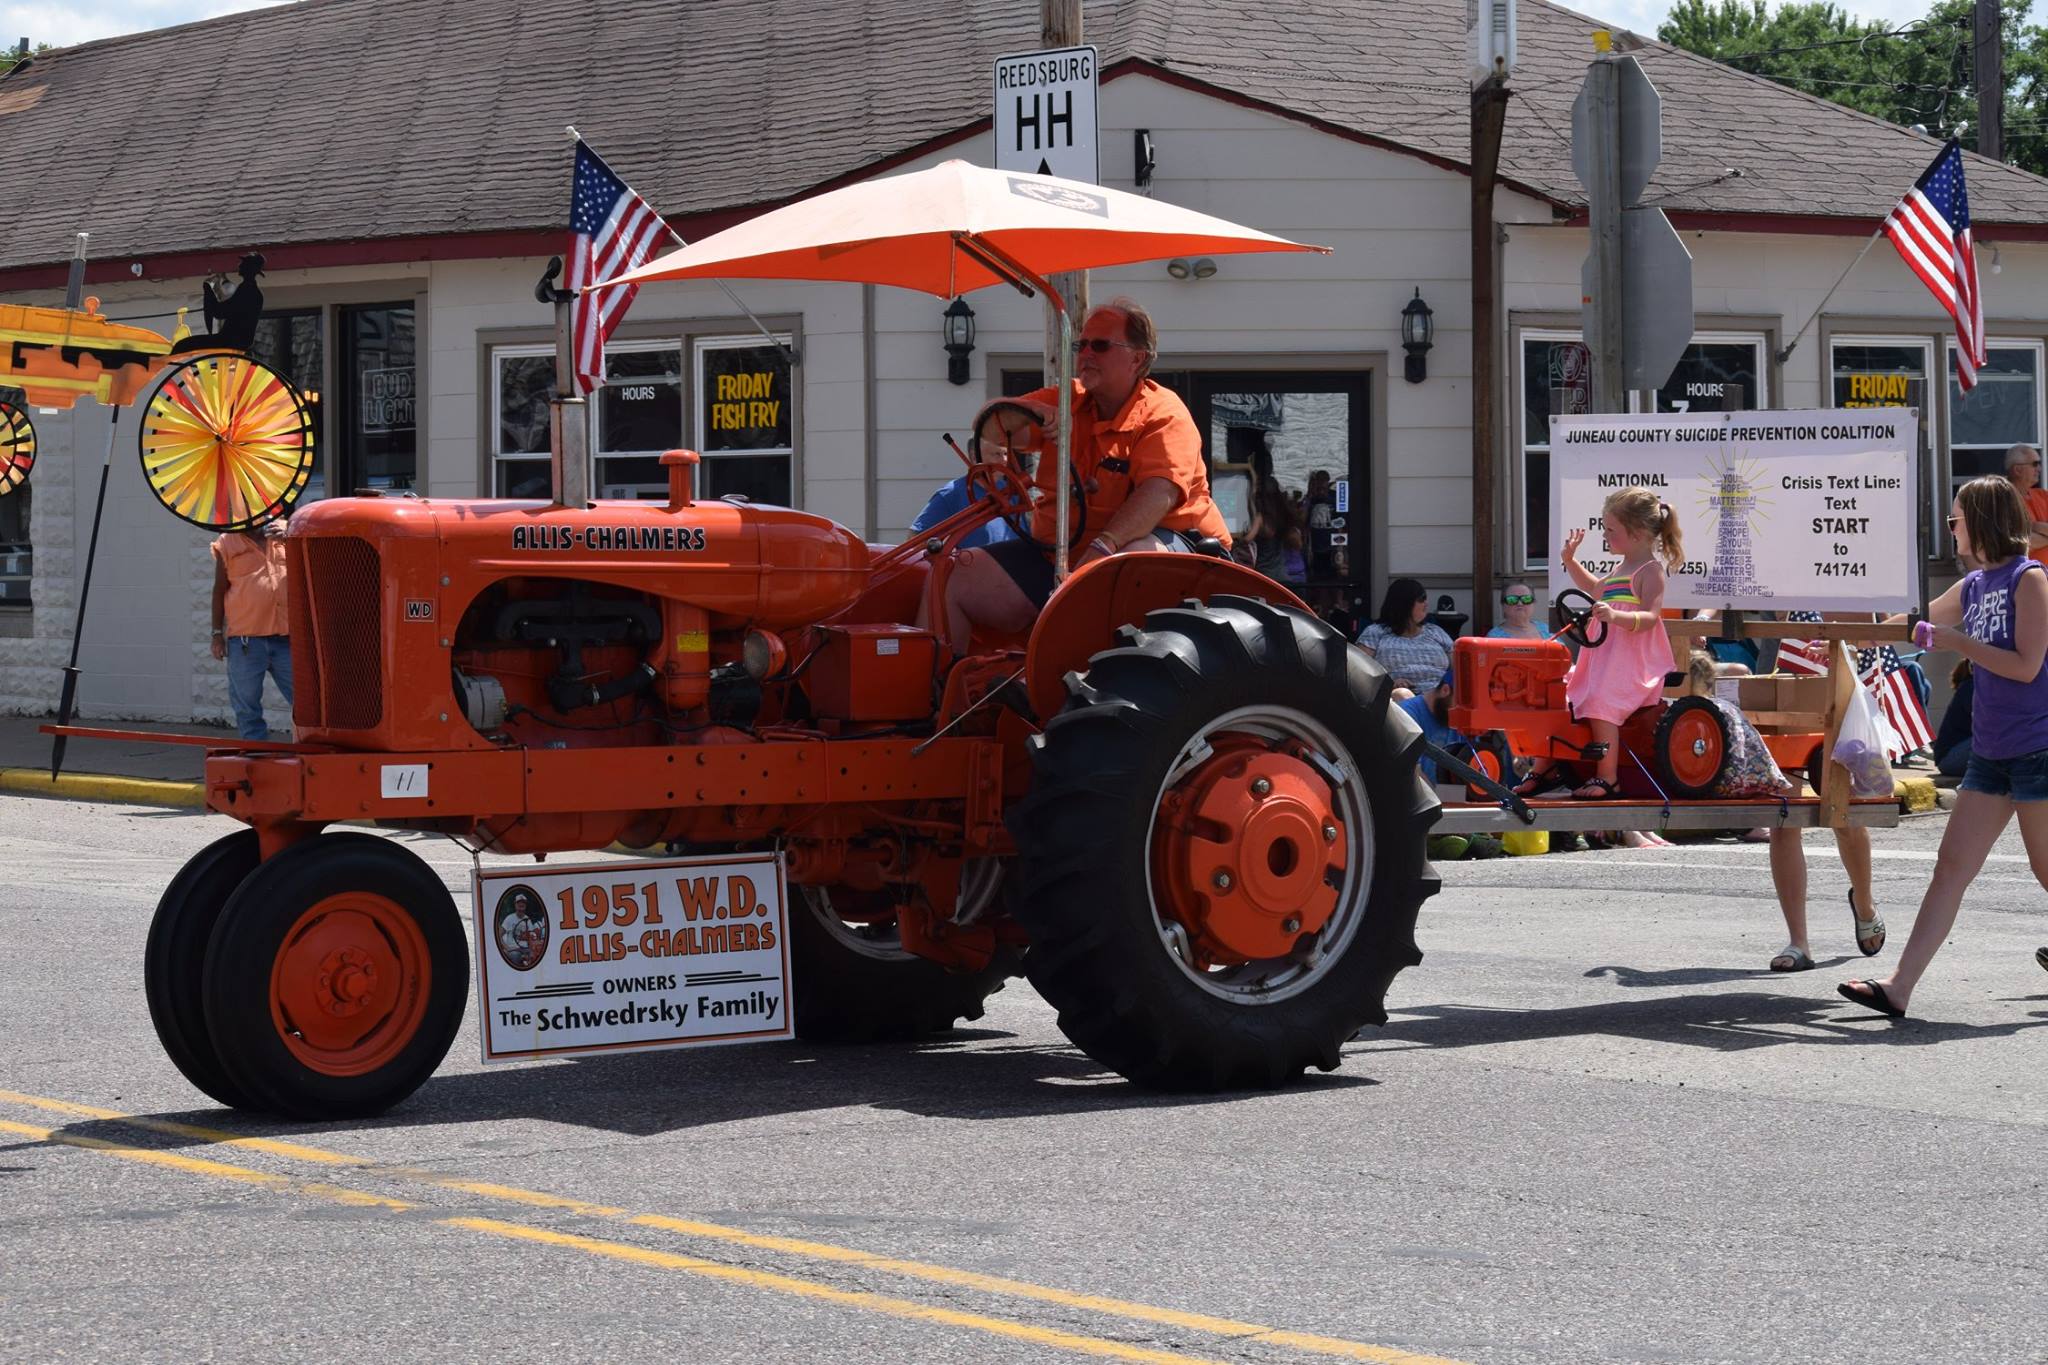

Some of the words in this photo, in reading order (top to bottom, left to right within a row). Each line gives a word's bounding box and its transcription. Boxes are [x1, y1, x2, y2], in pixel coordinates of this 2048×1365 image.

[1000, 56, 1090, 88] REEDSBURG
[1016, 91, 1073, 151] HH
[622, 386, 655, 400] HOURS
[717, 371, 774, 401] FRIDAY
[1850, 373, 1909, 400] FRIDAY
[712, 402, 746, 430] FISH
[750, 400, 780, 428] FRY
[1566, 430, 1620, 444] JUNEAU
[1619, 429, 1671, 443] COUNTY
[1675, 427, 1727, 442] SUICIDE
[1731, 426, 1817, 441] PREVENTION
[1821, 425, 1895, 440] COALITION
[1598, 473, 1669, 487] NATIONAL
[1723, 474, 1737, 483] YOU
[1781, 475, 1823, 490] Crisis
[1827, 475, 1860, 489] Text
[1864, 475, 1901, 489] Line:
[1721, 483, 1741, 493] HOPE
[1710, 496, 1741, 506] MATTER
[1824, 496, 1857, 510] Text
[1727, 528, 1747, 537] HOPE
[1812, 517, 1870, 534] START
[512, 525, 706, 551] ALLIS-CHALMERS
[1728, 538, 1742, 548] YOU
[1833, 542, 1848, 555] to
[1715, 556, 1740, 565] PEACE
[1666, 561, 1708, 578] (255)
[1713, 566, 1745, 576] MATTER
[1814, 562, 1867, 577] 741741
[1708, 583, 1732, 592] PEACE
[1742, 585, 1762, 595] HOPE
[407, 602, 432, 618] WD
[397, 770, 415, 791] 11
[557, 881, 664, 931] 1951
[676, 874, 768, 922] W.D.
[560, 921, 777, 965] ALLIS-CHALMERS
[602, 974, 677, 995] OWNERS
[499, 1010, 532, 1027] The
[537, 998, 689, 1032] Schwedrsky
[697, 990, 780, 1021] Family
